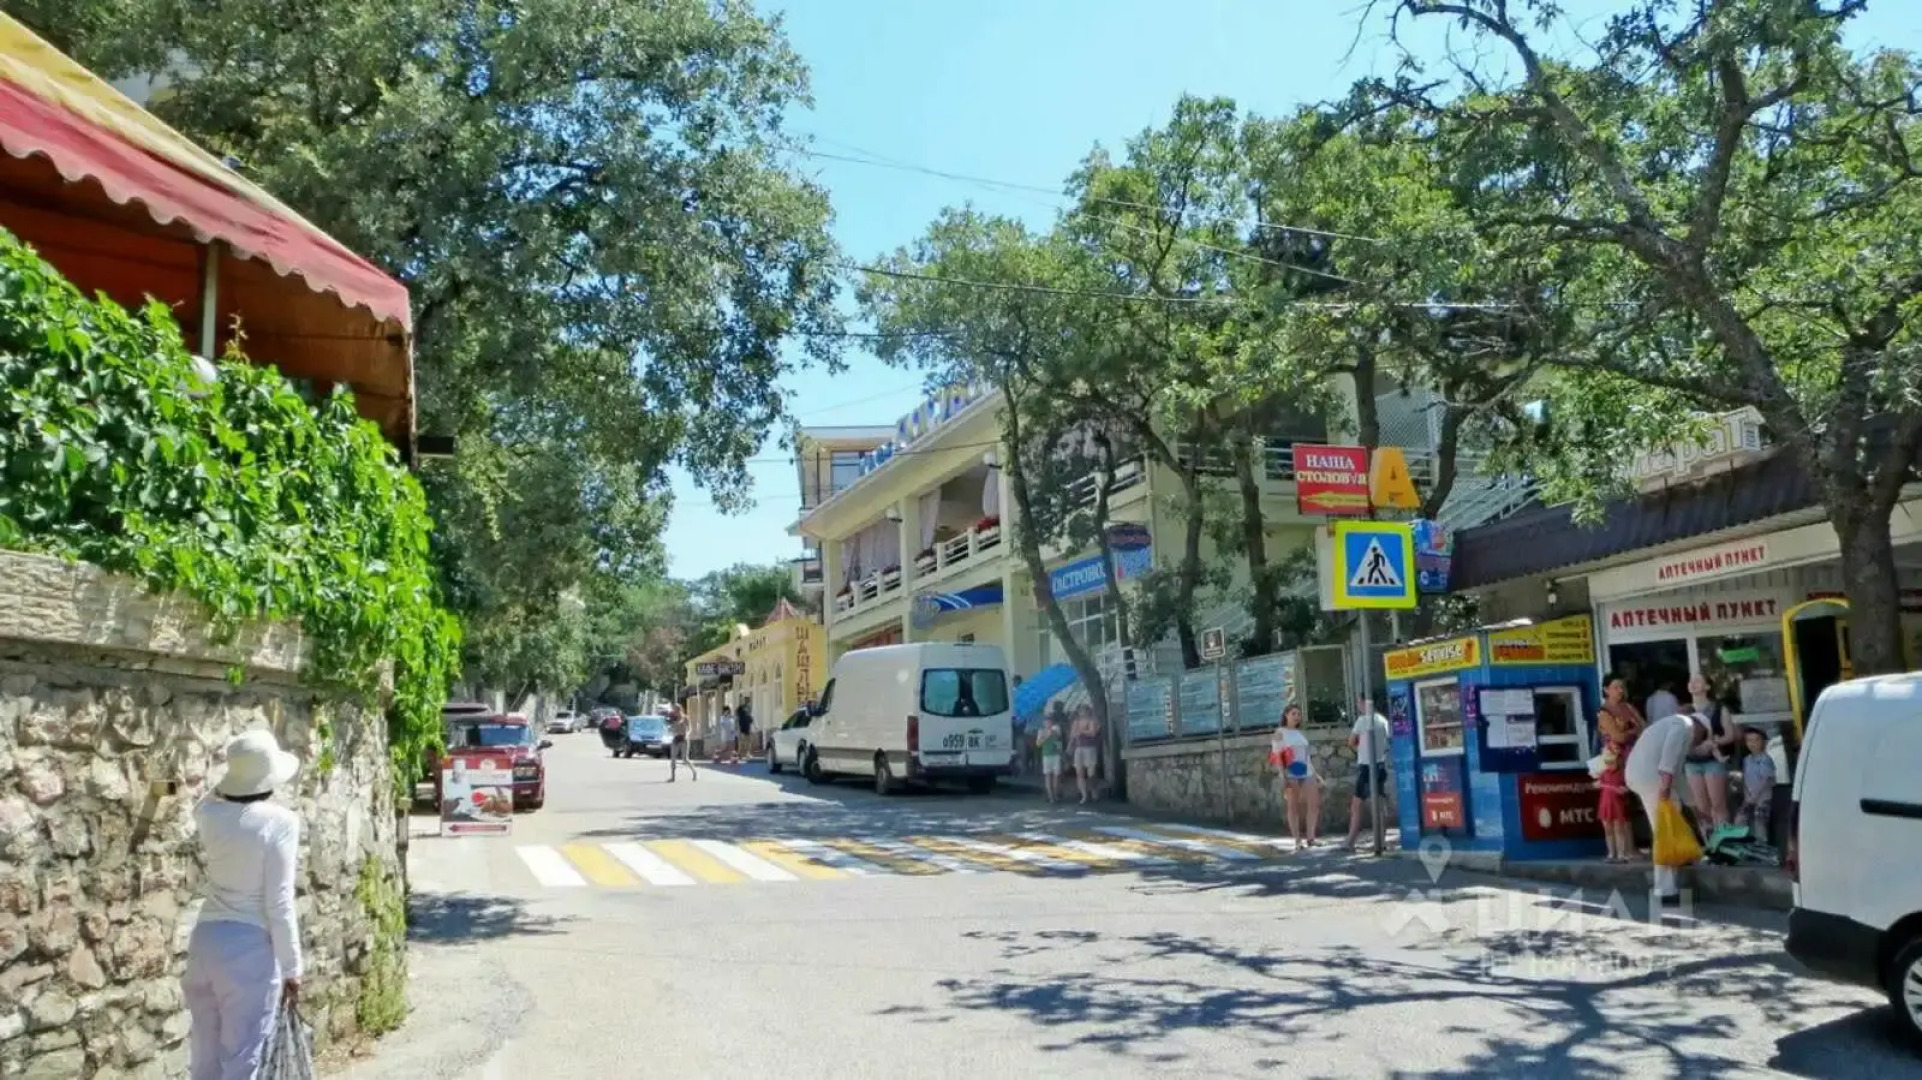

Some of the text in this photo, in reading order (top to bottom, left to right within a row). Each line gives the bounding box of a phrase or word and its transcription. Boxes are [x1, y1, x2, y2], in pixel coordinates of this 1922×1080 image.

[1306, 454, 1356, 469] НАША
[1658, 546, 1766, 580] АПТЕЧНЫЙ ПУНКТ
[1611, 599, 1778, 628] АПТЕЧНЫЙ ПУНКТ
[1559, 808, 1595, 824] МТС
